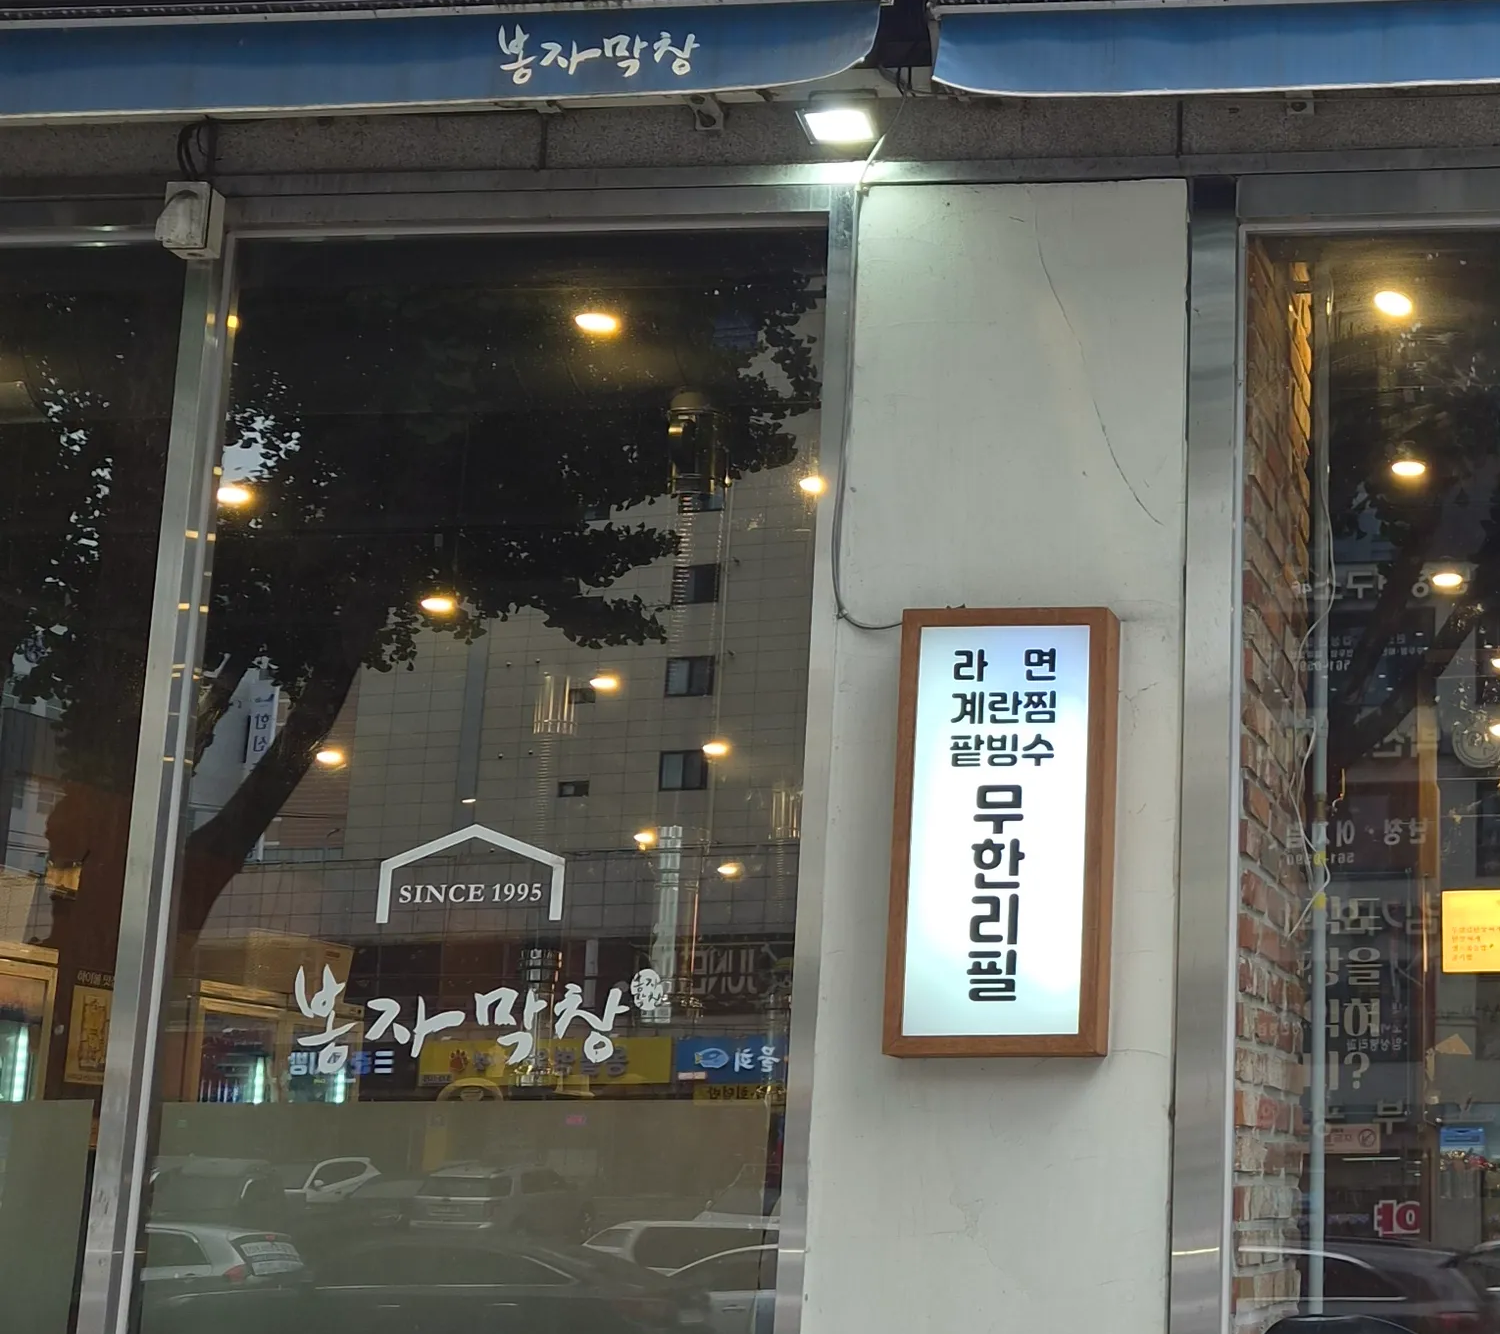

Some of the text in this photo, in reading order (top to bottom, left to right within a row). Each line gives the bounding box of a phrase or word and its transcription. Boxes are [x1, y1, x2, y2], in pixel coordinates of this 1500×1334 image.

[498, 23, 700, 85] 봉자막창
[950, 691, 1056, 725] 계란찜
[949, 733, 1055, 767] 팥빙수
[398, 883, 543, 904] SINCE 1995
[966, 784, 1025, 1002] 무한리필
[294, 964, 630, 1073] 봉자막창
